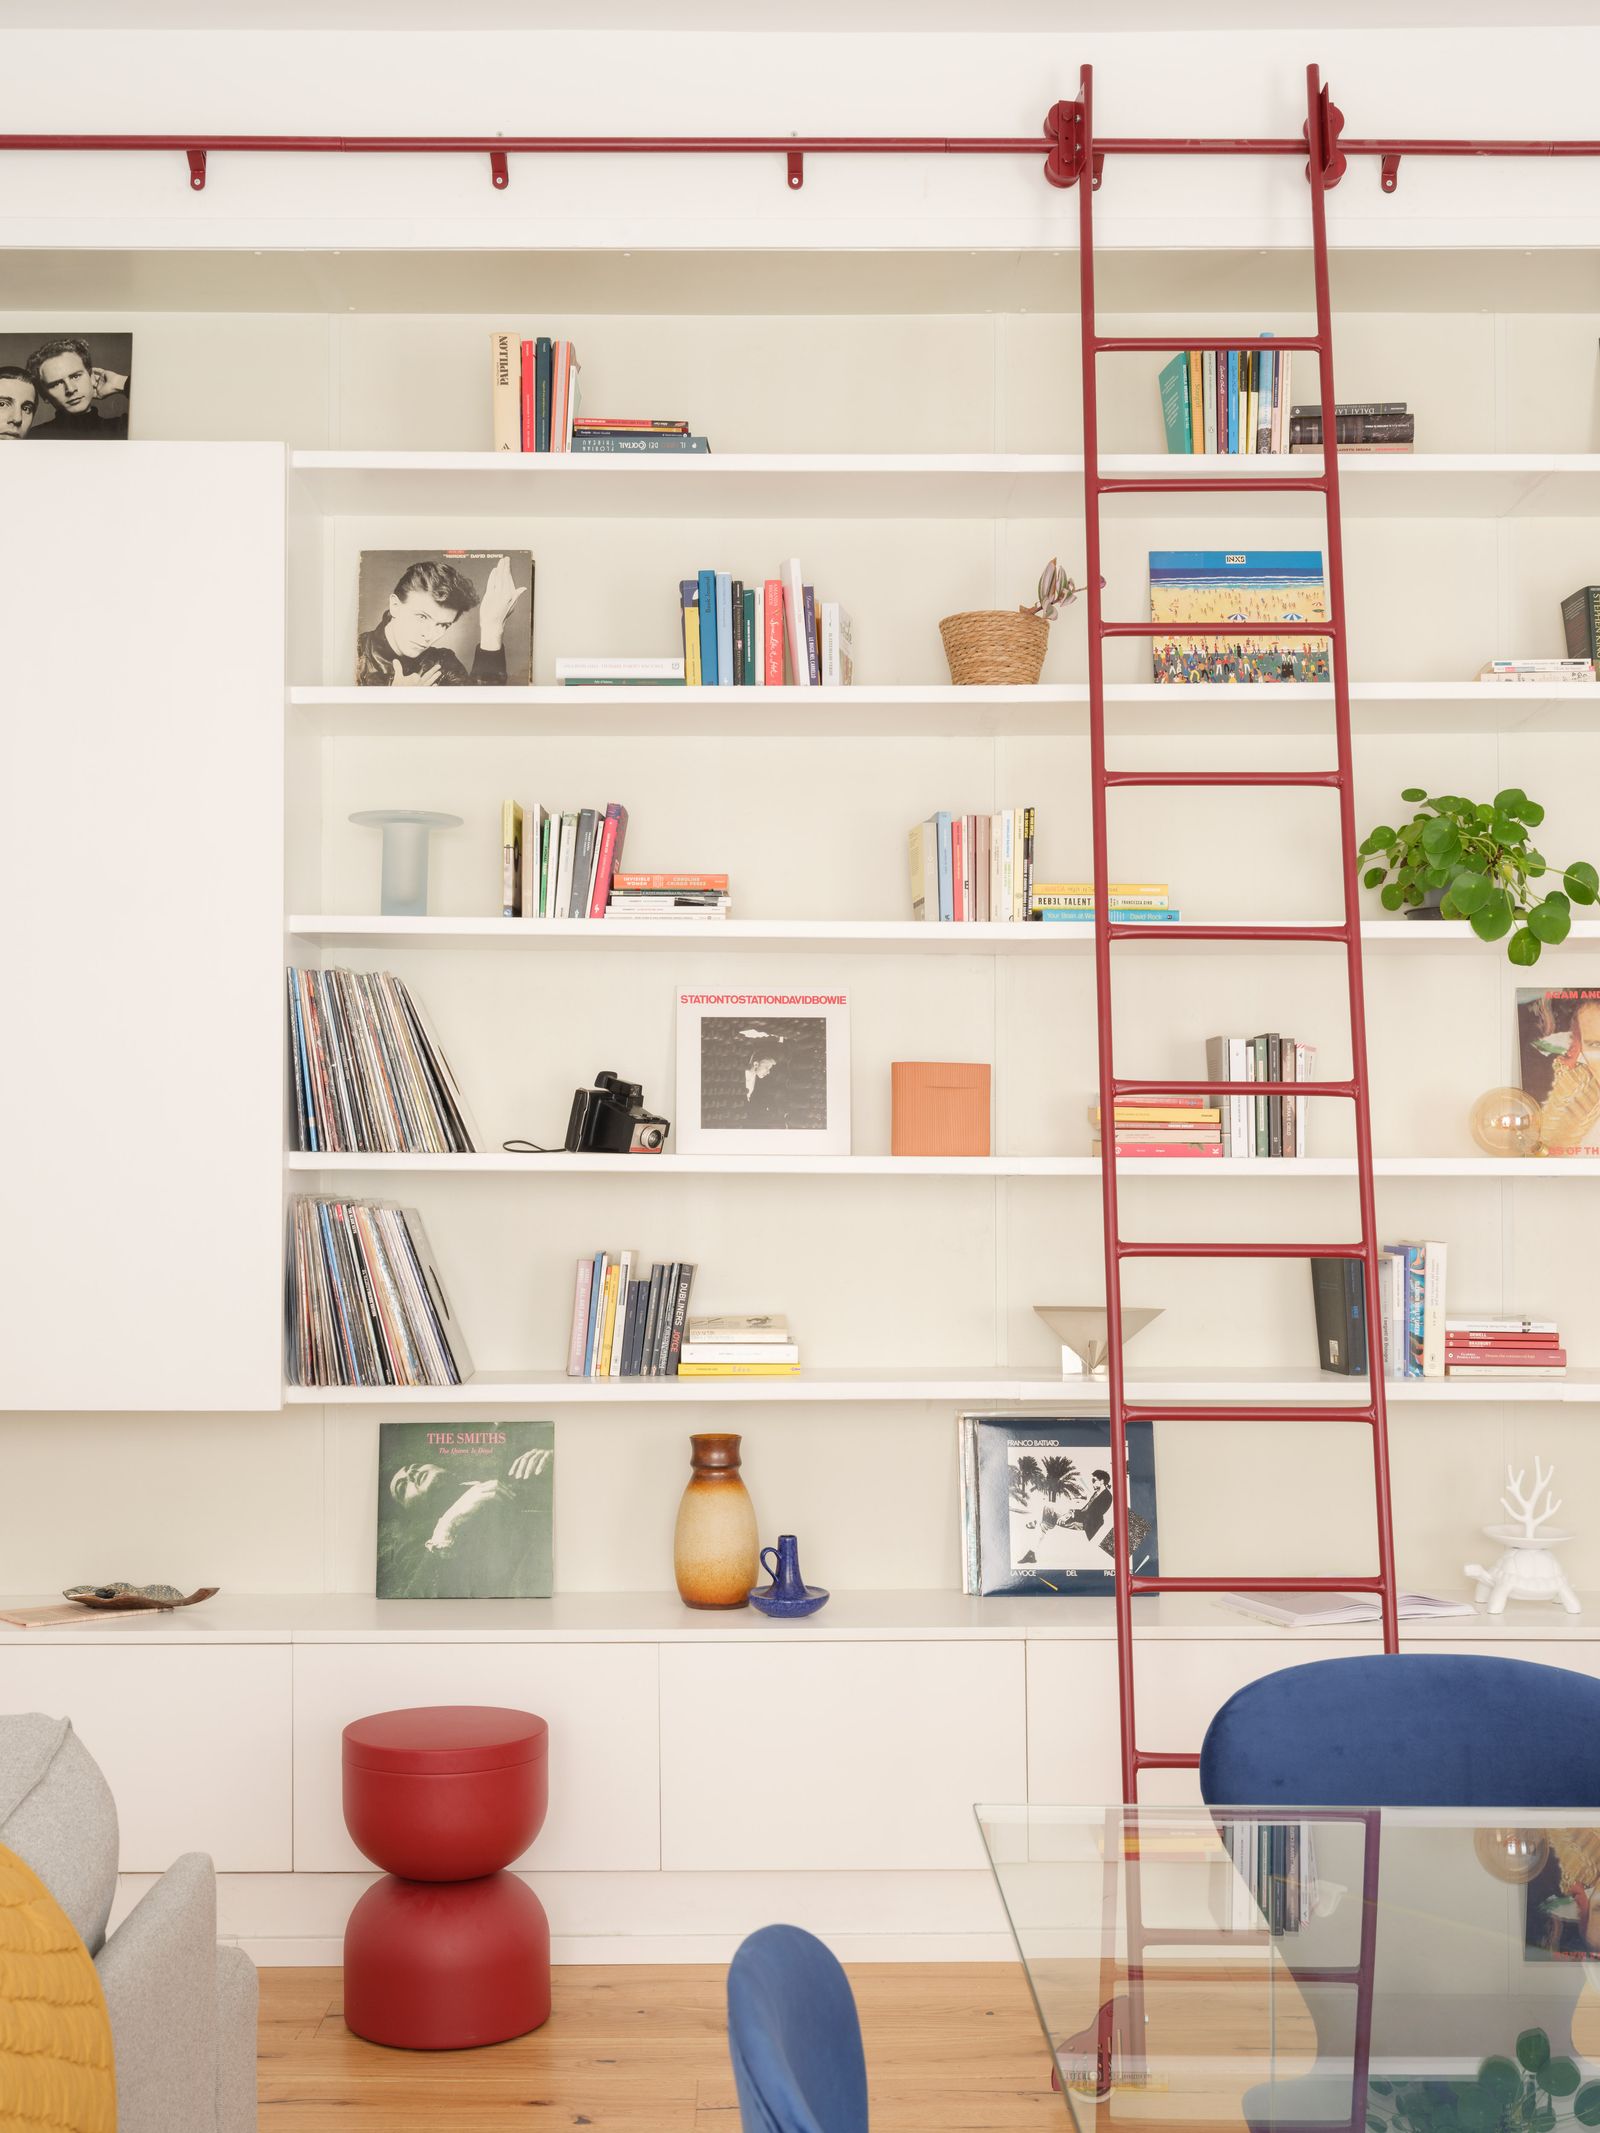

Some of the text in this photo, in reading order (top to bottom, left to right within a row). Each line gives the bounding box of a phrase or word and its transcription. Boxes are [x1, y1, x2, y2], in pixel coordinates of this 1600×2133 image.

[499, 335, 509, 386] PAPILLON
[1065, 898, 1091, 906] TALENT
[1545, 990, 1578, 999] ADAM
[680, 995, 847, 1004] STATIONTOSTATIONDAVIDBOWIE
[1567, 1146, 1581, 1155] OF
[1584, 1146, 1600, 1155] TH
[671, 1282, 688, 1352] DUBLINERS JOYCE
[427, 1432, 506, 1444] THE SMITHS
